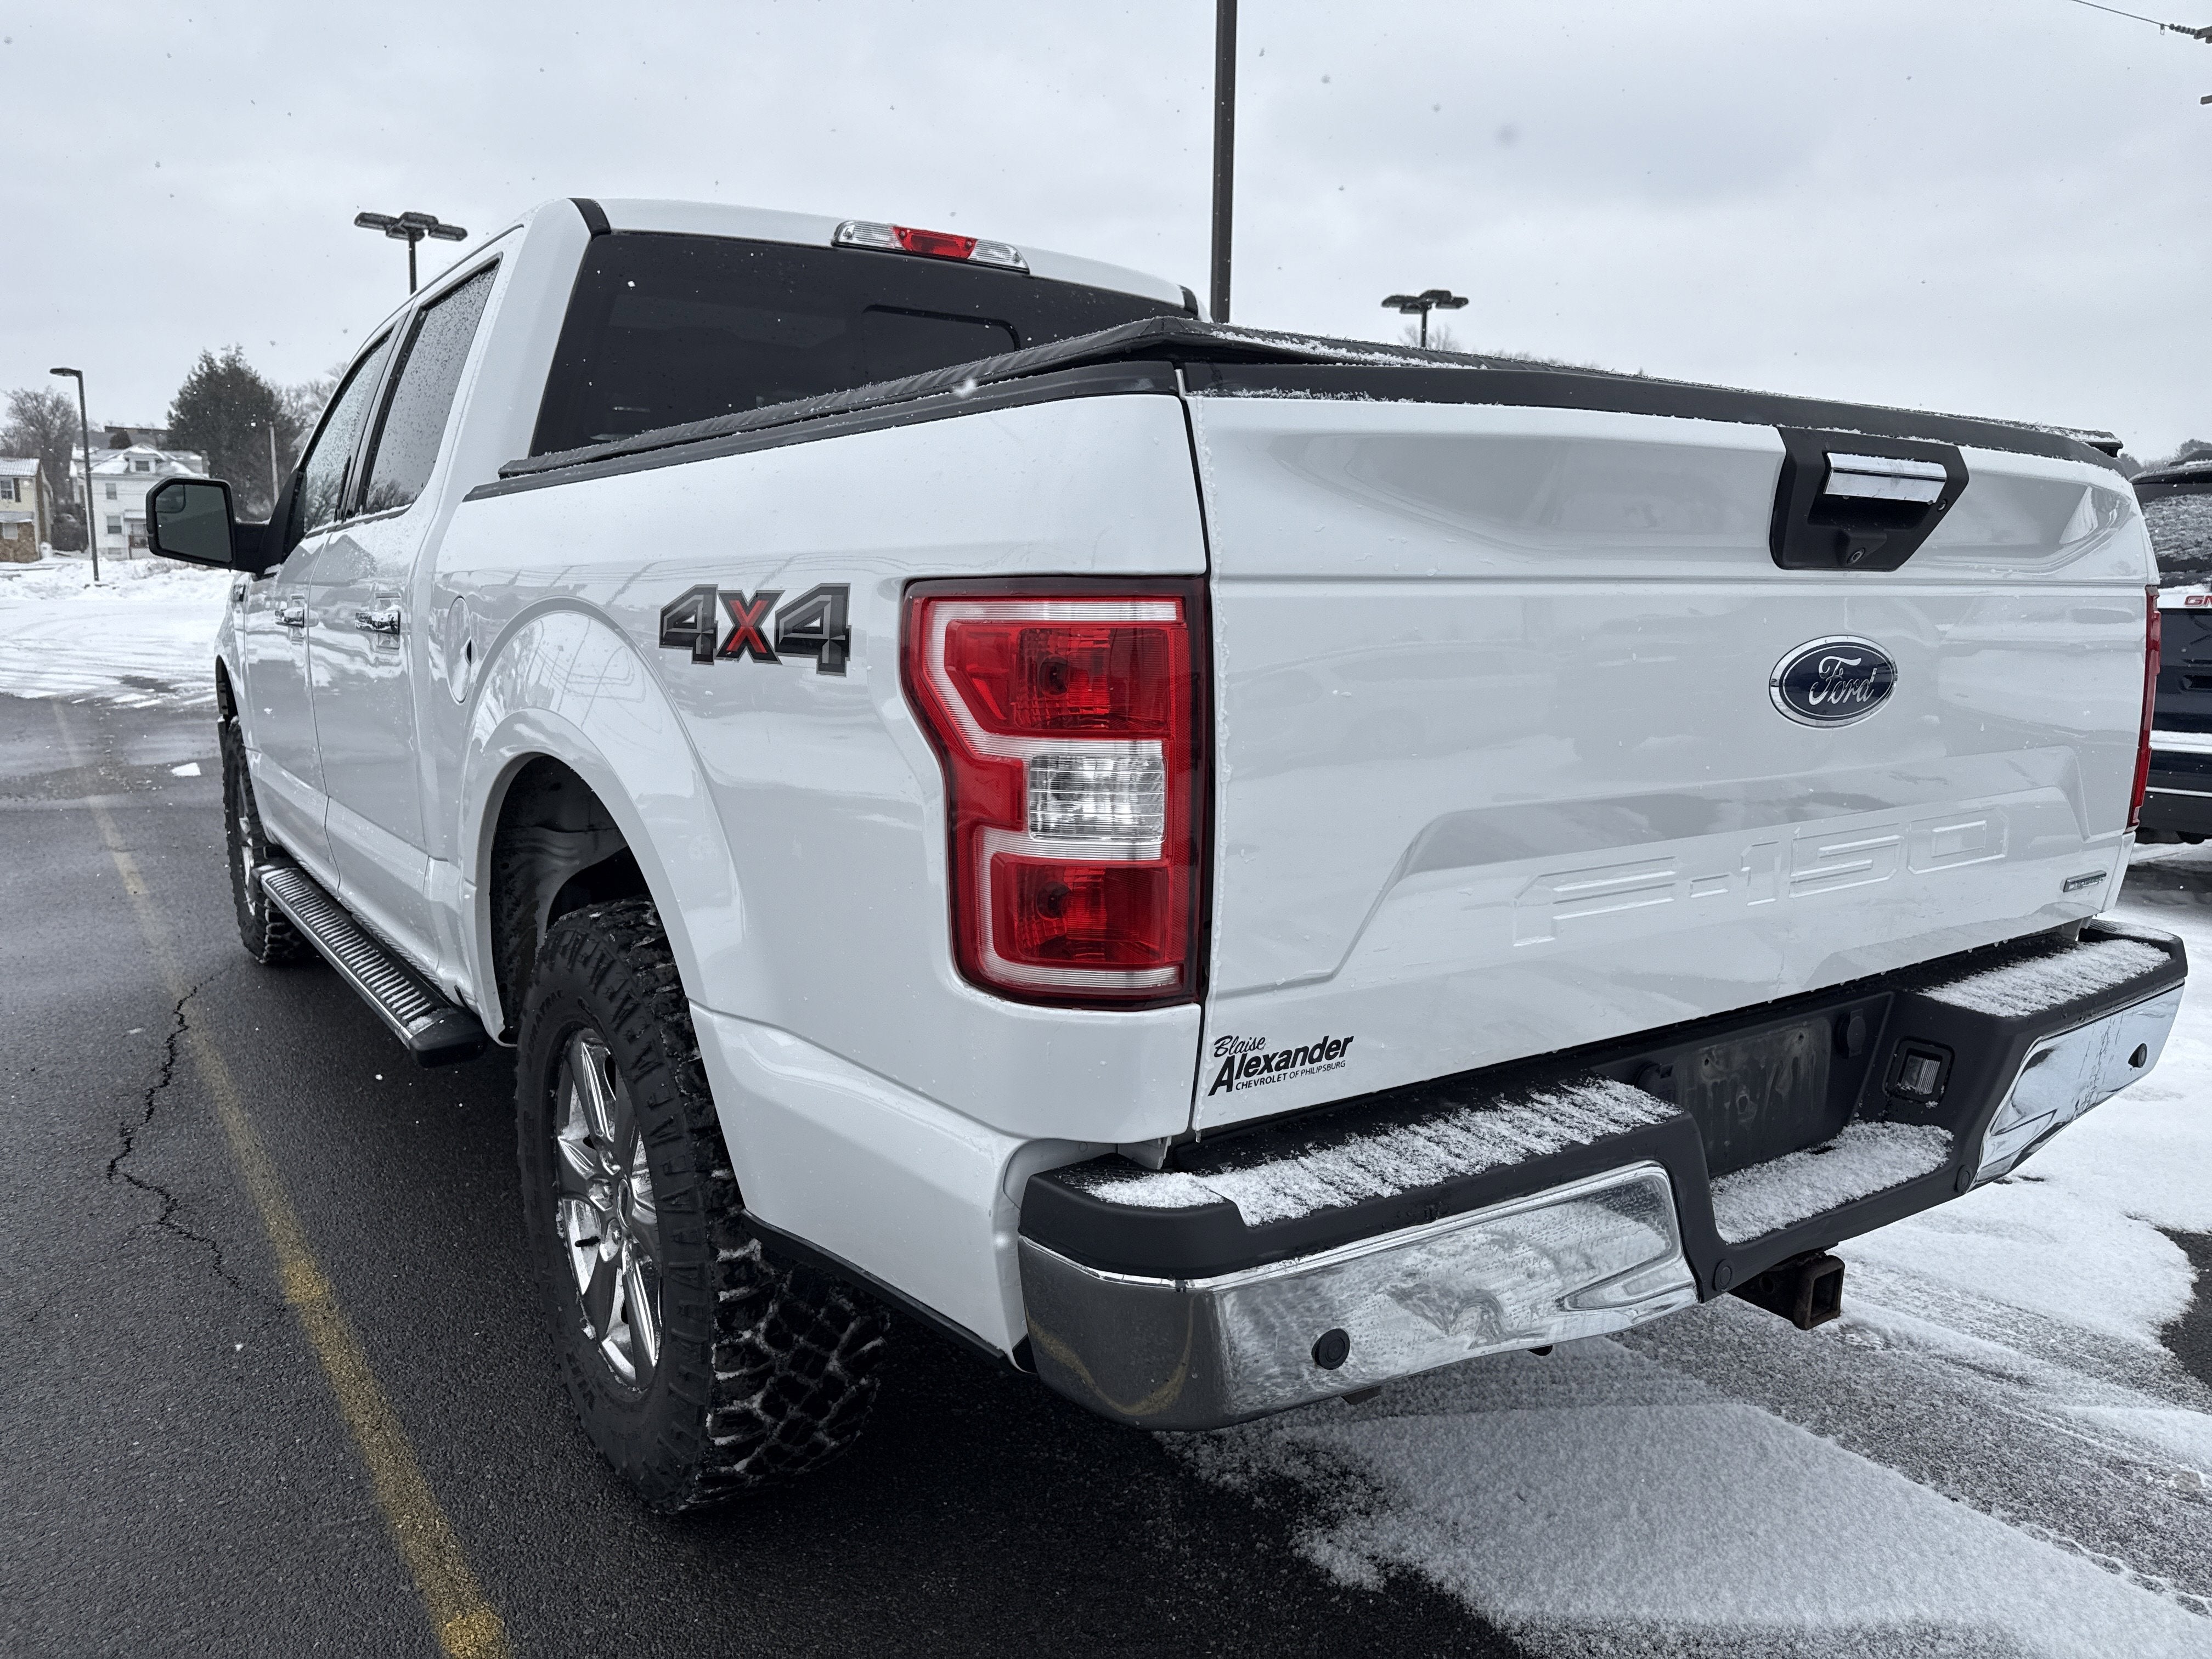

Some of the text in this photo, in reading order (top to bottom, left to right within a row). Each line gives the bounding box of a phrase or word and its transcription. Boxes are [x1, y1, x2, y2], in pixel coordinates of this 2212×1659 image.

[1809, 656, 1877, 706] Ford
[1513, 807, 2010, 947] F-150
[1207, 1036, 1354, 1096] Alexander
[1214, 1035, 1266, 1058] Blaise
[1235, 1060, 1346, 1091] CHEVROLET OF PHILIPSBURG
